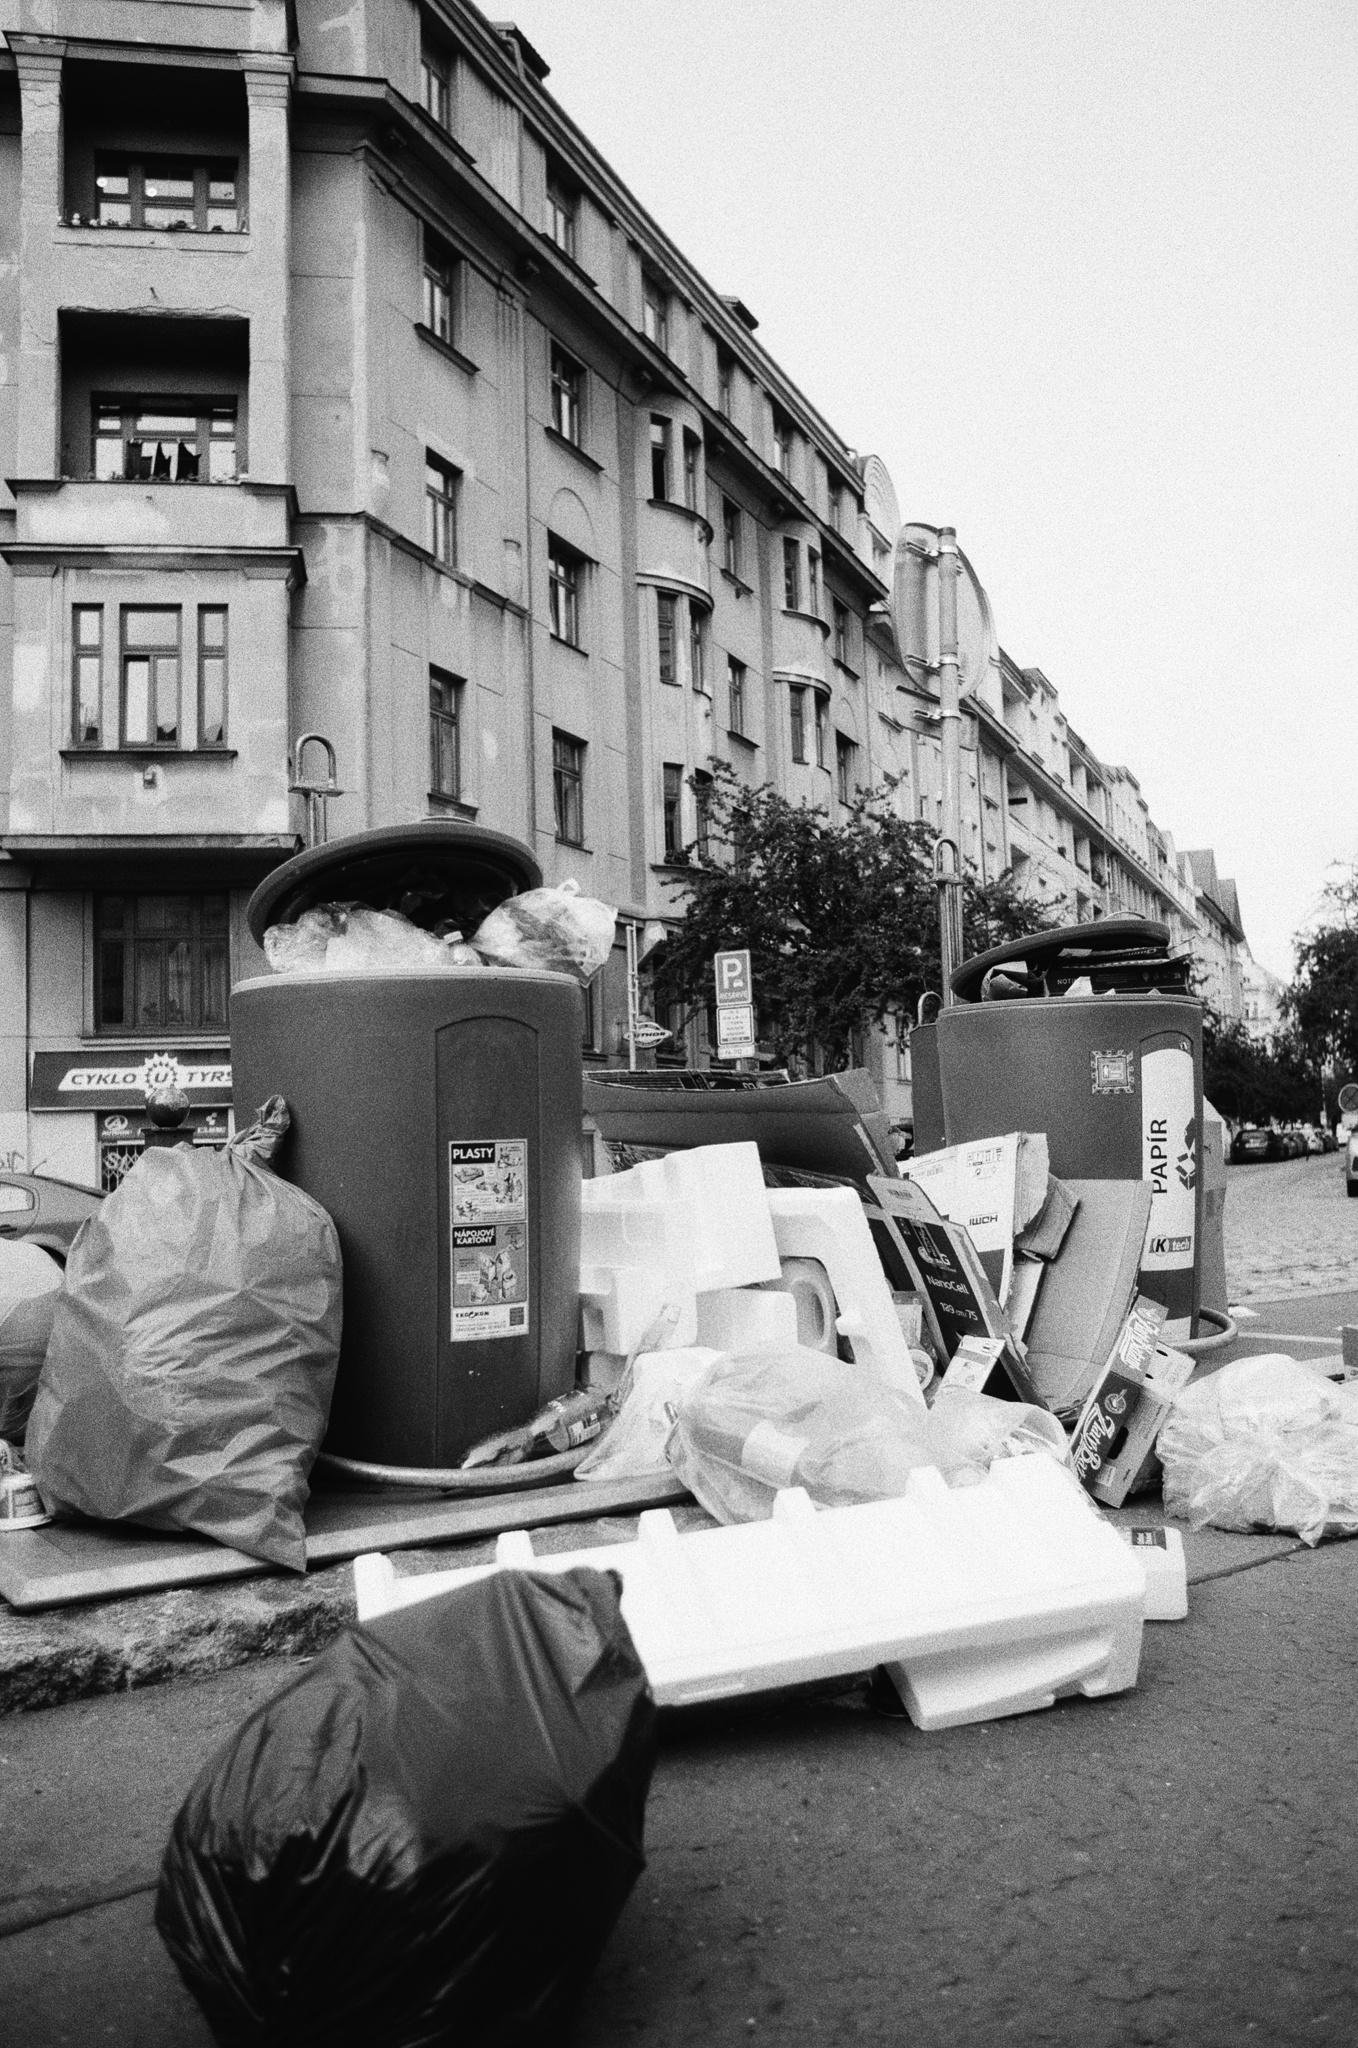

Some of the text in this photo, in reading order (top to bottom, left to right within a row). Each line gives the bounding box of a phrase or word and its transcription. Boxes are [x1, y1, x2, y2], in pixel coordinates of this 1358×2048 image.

[721, 957, 744, 989] P
[71, 1073, 137, 1085] CYKLO
[154, 1072, 169, 1083] U
[452, 1147, 495, 1160] PLASTY
[1146, 1119, 1168, 1194] PAPÍR
[454, 1227, 495, 1238] NÁPOJOVÉ
[456, 1236, 493, 1245] KARTONY
[1155, 1239, 1191, 1254] K tech
[925, 1274, 970, 1295] NanoCell
